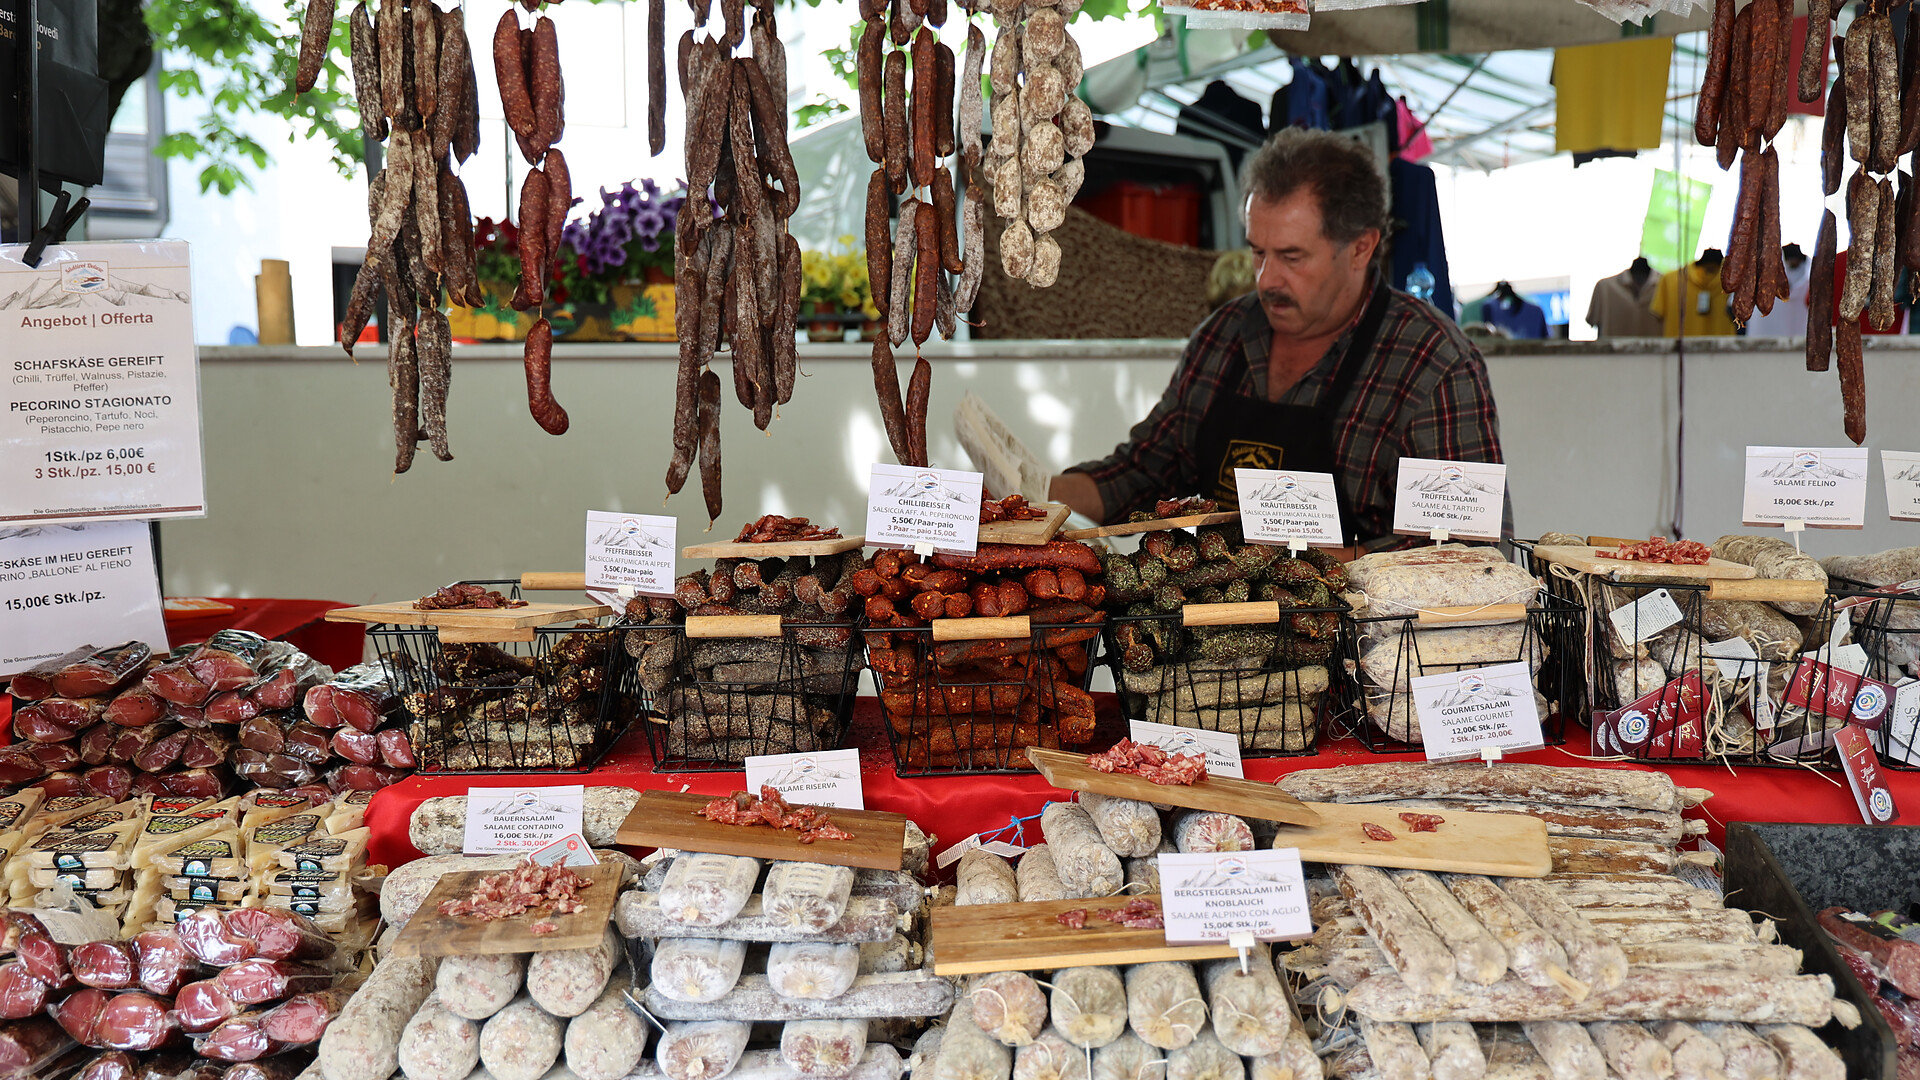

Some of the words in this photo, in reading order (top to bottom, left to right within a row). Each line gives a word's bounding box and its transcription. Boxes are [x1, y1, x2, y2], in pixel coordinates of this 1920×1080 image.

[21, 313, 87, 330] Angebot
[101, 312, 153, 326] Offerta
[14, 357, 104, 371] SCHAFSKÄSE
[108, 355, 164, 368] GEREIFT
[12, 375, 43, 385] (Chilli,
[45, 372, 78, 383] Trüffel,
[81, 371, 124, 381] Walnuss,
[128, 369, 167, 380] Pistazie,
[73, 383, 109, 392] Pfeffer)
[11, 399, 81, 412] PECORINO
[84, 395, 172, 409] STAGIONATO
[25, 413, 91, 425] (Peperoncino,
[96, 411, 130, 421] Tartufo,
[134, 410, 158, 419] Noci,
[41, 424, 92, 435] Pistacchio,
[96, 423, 120, 432] Pepe
[123, 422, 144, 430] nero
[45, 450, 102, 463] 1Stk./pz
[107, 447, 144, 461] 6,00€
[35, 468, 43, 479] 3
[48, 465, 101, 479] Stk./pz.
[106, 463, 143, 476] 15,00
[147, 462, 156, 473] €
[1421, 493, 1477, 503] TRÜFFELSALAMI
[1773, 498, 1801, 506] 18,00€
[1804, 499, 1834, 507] Stk./pz
[898, 499, 950, 510] CHILLIBEISSER
[1261, 502, 1317, 510] KRÄUTERBEISSER
[873, 506, 904, 515] SALSICCIA
[930, 511, 974, 521] PEPERONCINO
[892, 517, 953, 528] 5,50€/Paar-paio
[1263, 518, 1319, 526] 5,50€/Paar-paio
[934, 529, 957, 537] 15,00€
[45, 555, 57, 565] IM
[60, 553, 83, 563] HEU
[86, 546, 133, 559] GEREIFT
[605, 547, 652, 557] PFEFFERBEISSER
[86, 564, 98, 572] AL
[101, 559, 132, 569] FIENO
[589, 555, 614, 563] SALSICCIA
[615, 557, 648, 566] AFFUMICATA
[604, 565, 653, 575] 5,50€/Paar-paio
[5, 595, 50, 611] 15,00€
[54, 591, 106, 605] Stk./pz.
[1442, 700, 1510, 715] GOURMETSALAMI
[1442, 717, 1473, 726] SALAME
[1475, 710, 1514, 722] GOURMET
[1452, 726, 1477, 734] 12,00€
[1479, 723, 1507, 732] Stk./pz.
[1457, 734, 1485, 742] Stk./pz.
[1488, 730, 1513, 739] 20,00€
[806, 782, 837, 790] RISERVA
[1174, 887, 1272, 897] BERGSTEIGERSALAMI
[1205, 899, 1264, 907] KNOBLAUCH
[1171, 911, 1209, 920] SALAME
[1212, 910, 1247, 919] ALPINO
[1249, 908, 1269, 916] CON
[1272, 906, 1300, 915] AGLIO
[1236, 920, 1271, 928] Stk./pz.
